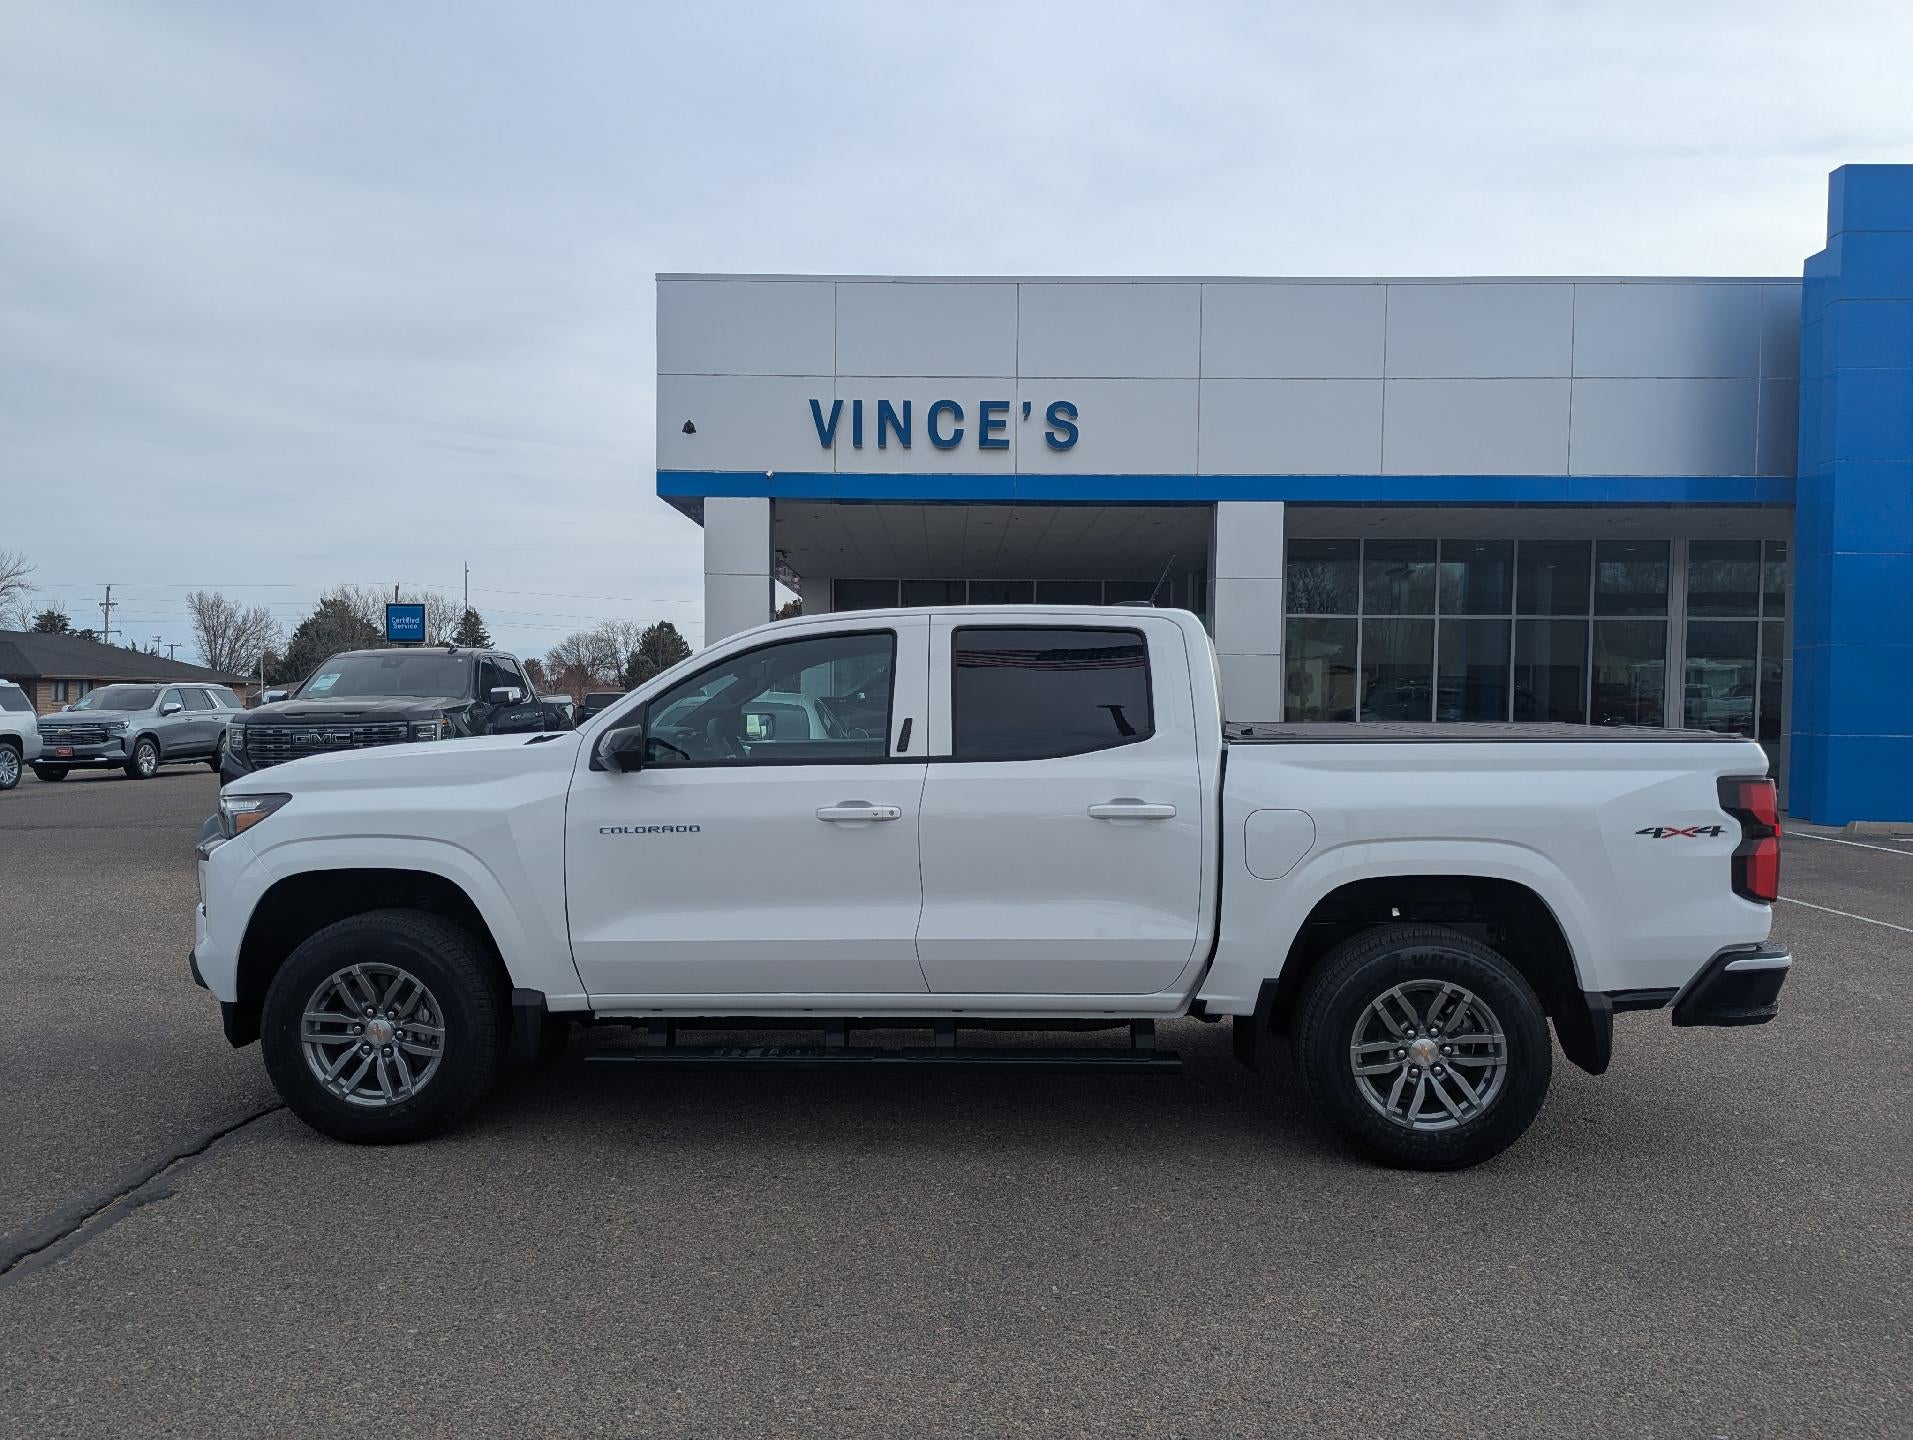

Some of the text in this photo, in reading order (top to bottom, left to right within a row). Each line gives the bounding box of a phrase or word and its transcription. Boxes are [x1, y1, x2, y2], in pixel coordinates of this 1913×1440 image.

[808, 399, 1081, 451] VINCE'S
[391, 616, 420, 624] Certified
[292, 732, 351, 745] GMC
[599, 824, 702, 835] COLORADO
